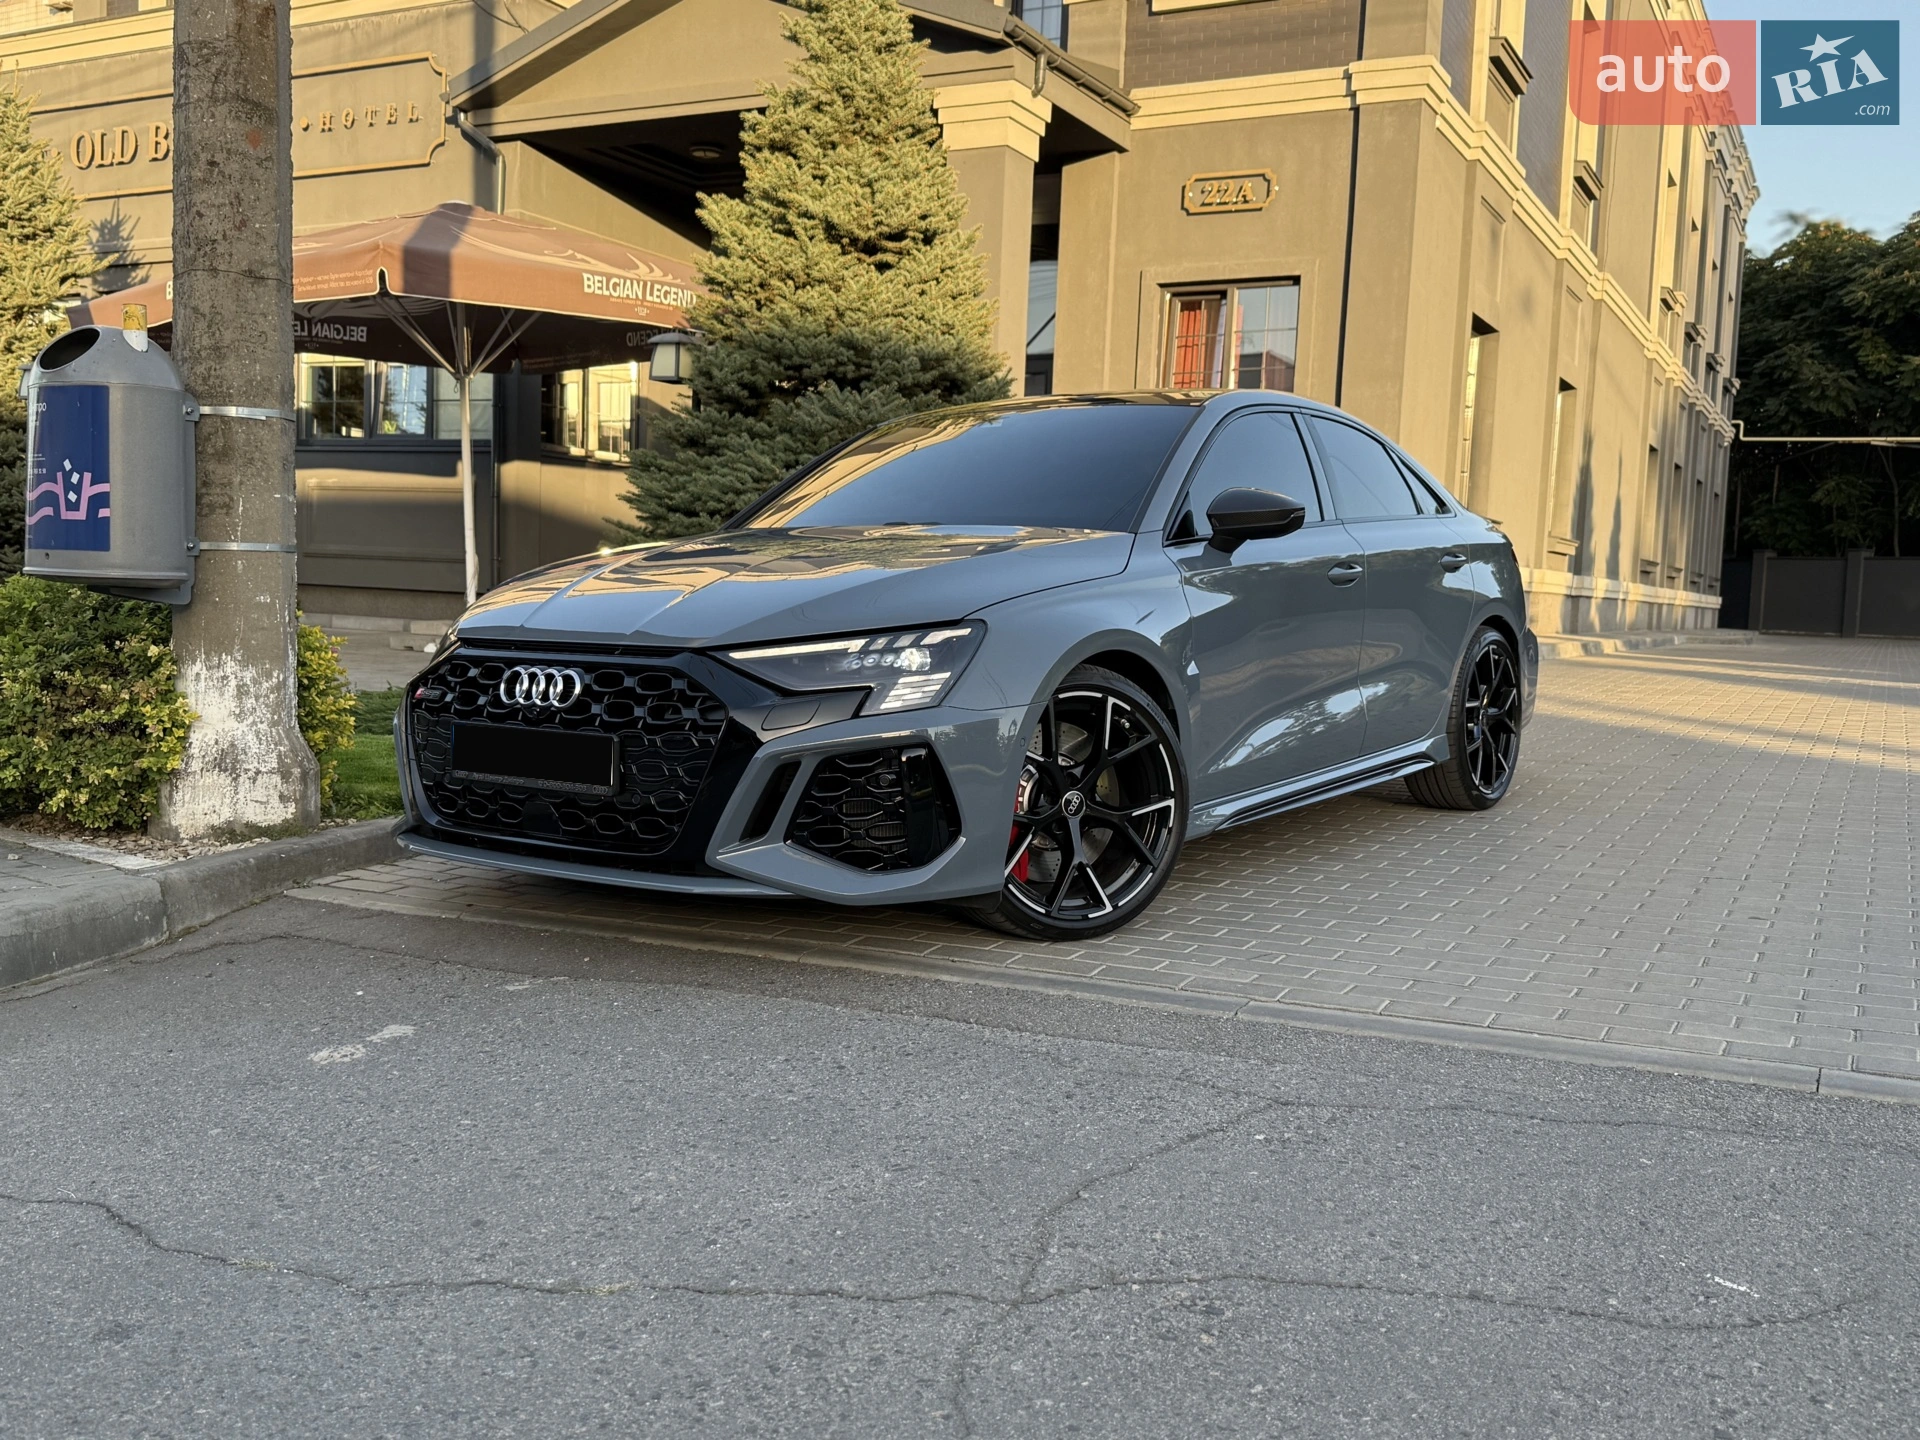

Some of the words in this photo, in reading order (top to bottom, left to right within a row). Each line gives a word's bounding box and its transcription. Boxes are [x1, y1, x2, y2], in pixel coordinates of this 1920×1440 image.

[70, 126, 138, 169] OLD
[147, 121, 173, 162] B
[319, 101, 421, 132] HOTEL
[1201, 179, 1255, 207] 22A
[166, 280, 173, 301] B
[582, 272, 643, 300] BELGIAN
[646, 280, 697, 308] LEGEND
